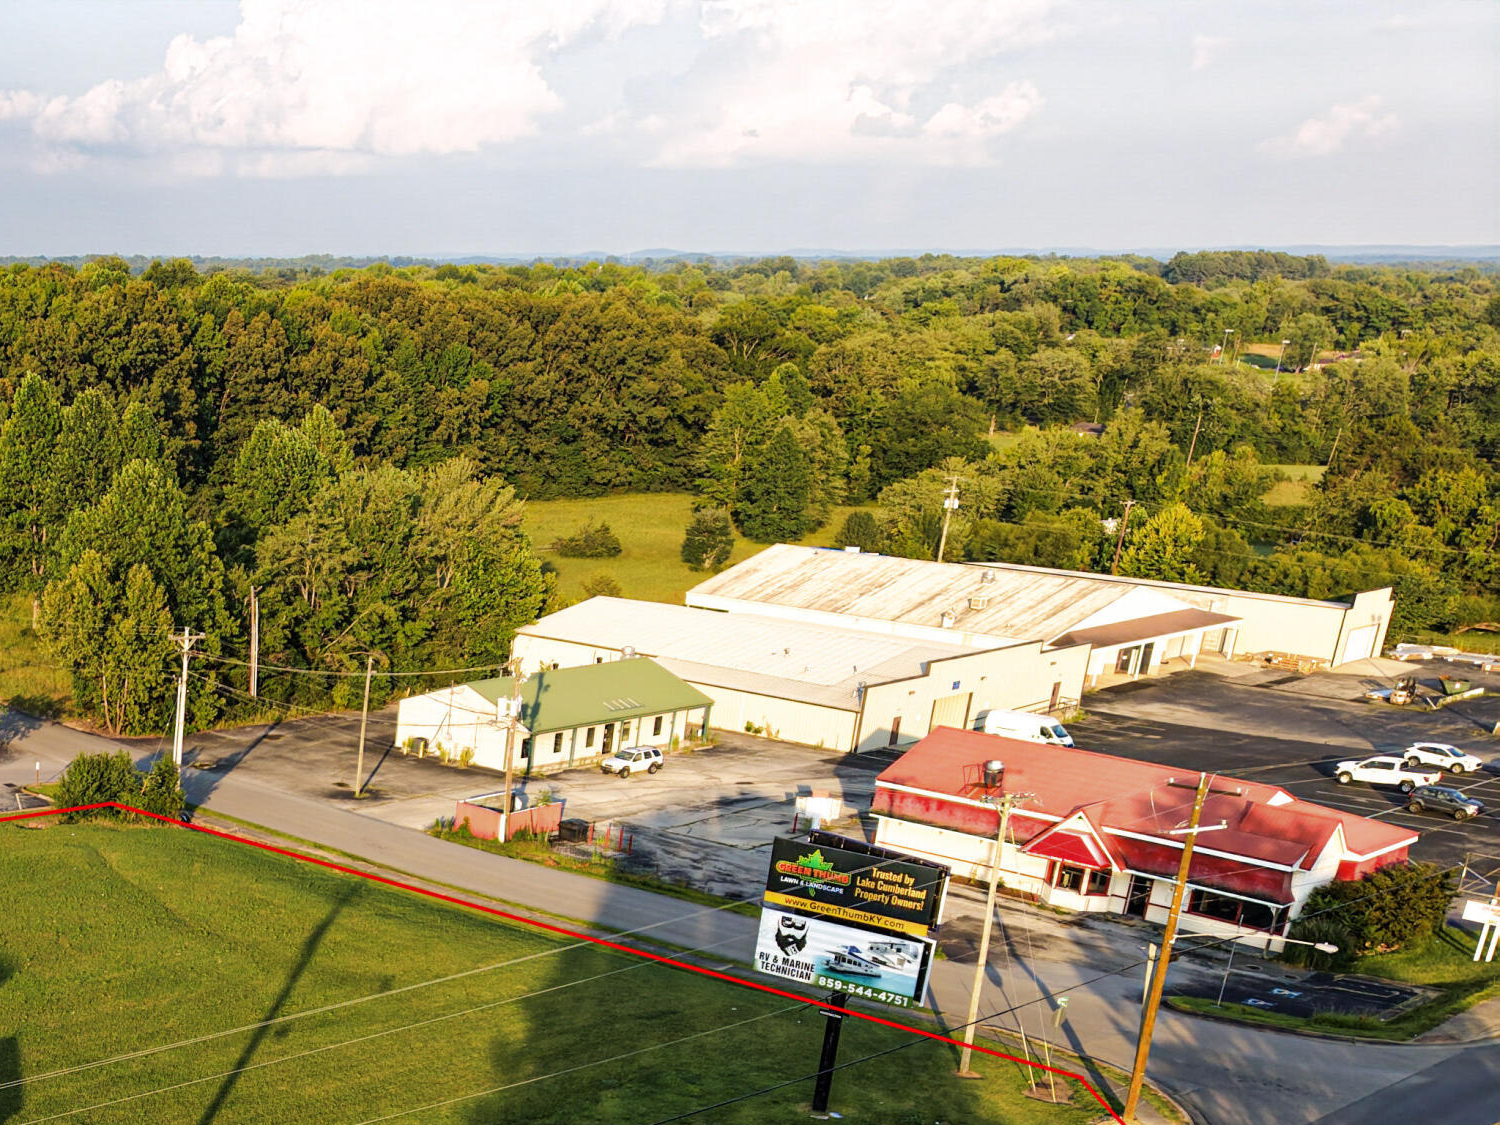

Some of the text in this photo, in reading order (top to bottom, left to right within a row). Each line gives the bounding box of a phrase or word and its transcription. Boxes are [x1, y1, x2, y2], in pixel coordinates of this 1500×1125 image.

[779, 863, 849, 884] GREEN THUMB
[872, 867, 915, 886] Trusted by
[780, 876, 799, 884] LAWN
[806, 881, 844, 894] LANDSCAPE
[856, 876, 927, 899] Lake Cumberland
[854, 887, 925, 911] Property Owners!
[784, 897, 905, 929] www.GreenThumbKYcom
[759, 951, 815, 973] RV & MARINE
[761, 961, 811, 980] TECHNICIAN
[818, 976, 909, 1007] 859-544-4751
